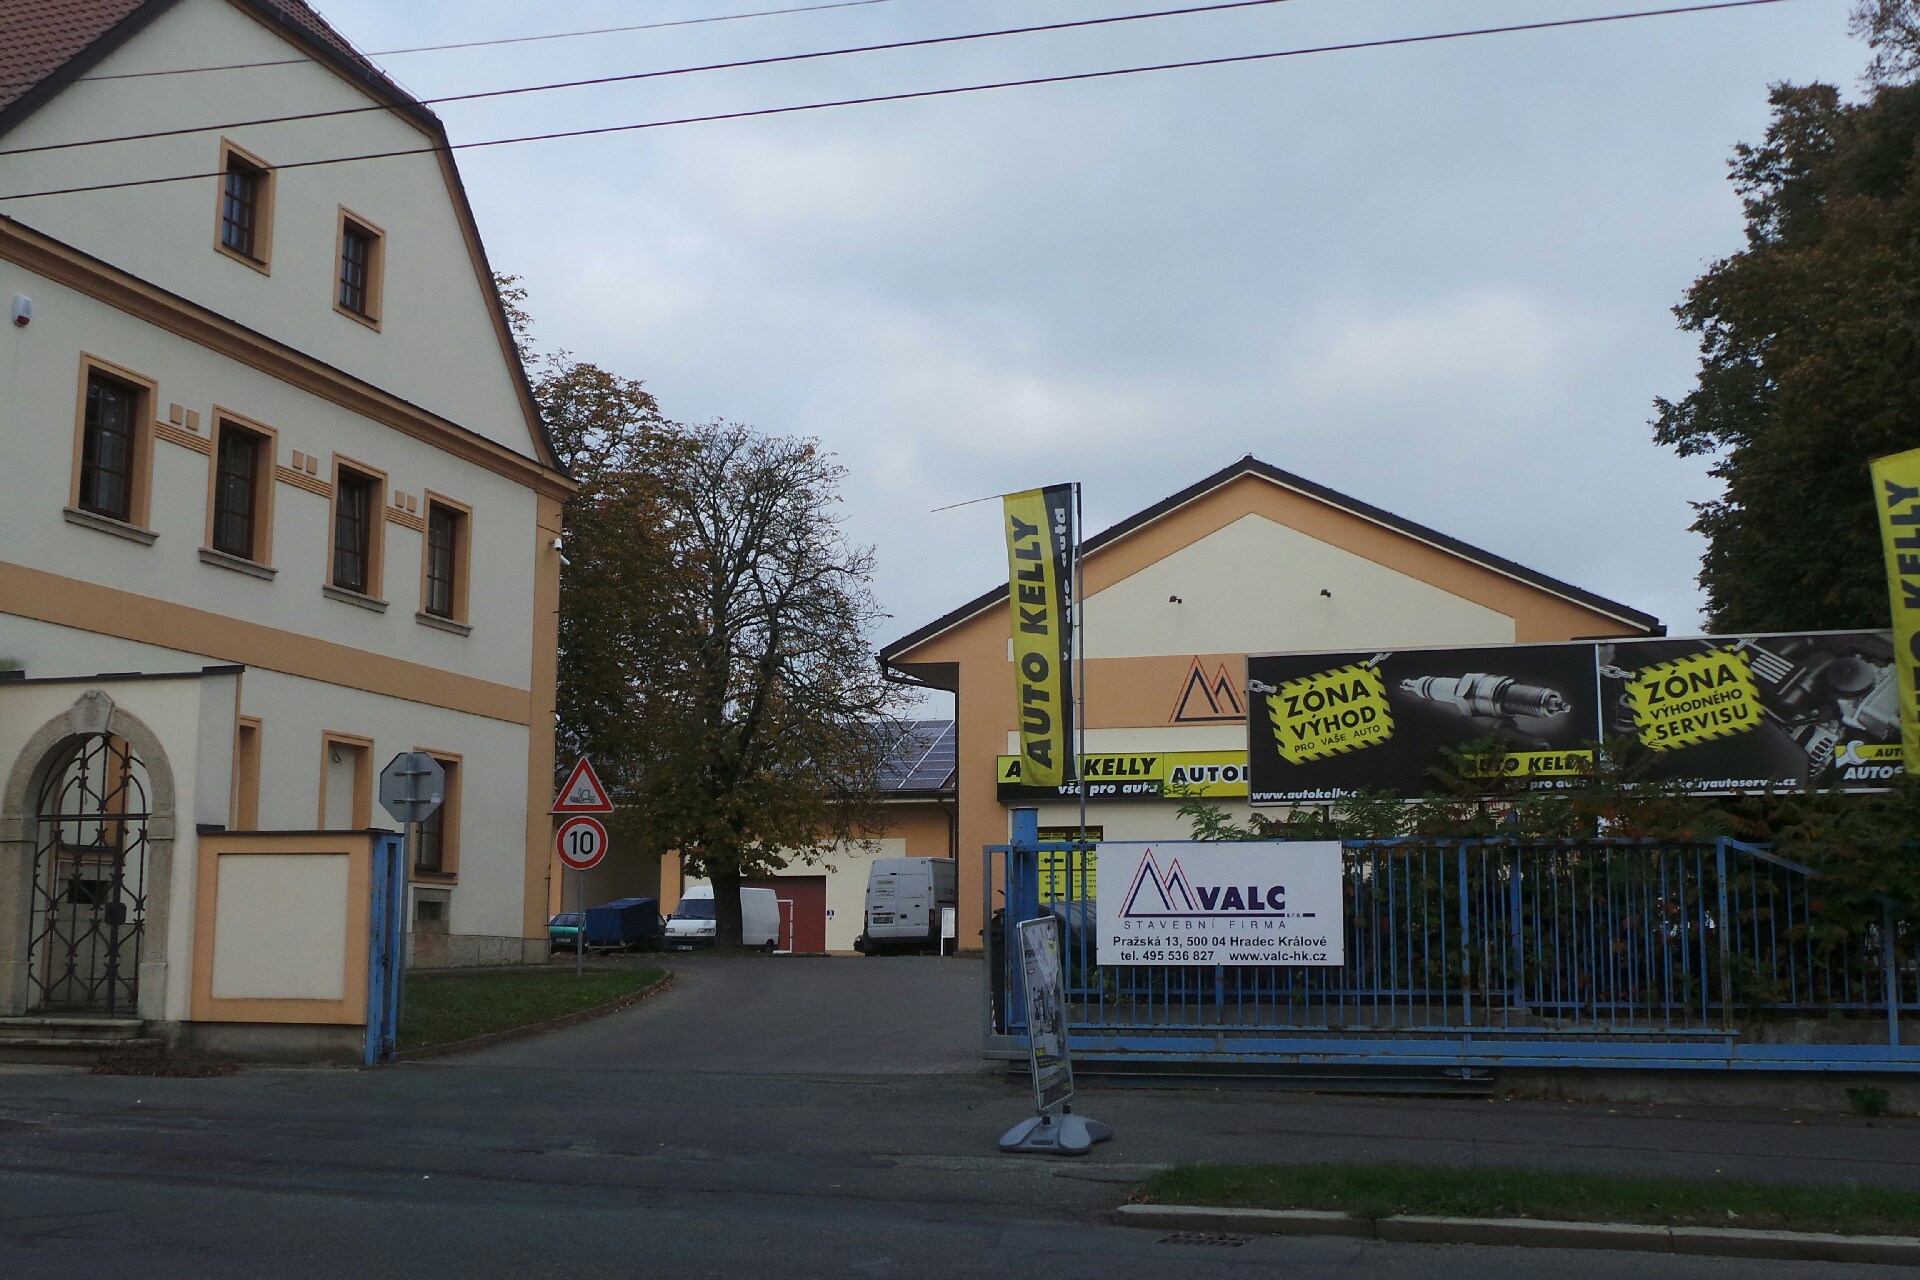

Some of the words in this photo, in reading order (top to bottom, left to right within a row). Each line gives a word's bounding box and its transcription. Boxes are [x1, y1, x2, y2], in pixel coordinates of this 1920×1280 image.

[1010, 515, 1048, 635] KELLY
[1644, 664, 1738, 705] ZÓNA
[1021, 652, 1053, 769] AUTO
[1284, 679, 1371, 718] ZÓNA
[1650, 688, 1742, 720] VÝHODNÉHO
[1290, 706, 1376, 741] VÝHOD
[1655, 703, 1749, 740] SERVISU
[1294, 742, 1315, 753] PRO
[1321, 733, 1346, 746] VAŠE
[1353, 725, 1381, 738] AUTO
[1084, 757, 1157, 776] KELLY
[1090, 785, 1116, 796] pro
[1530, 779, 1553, 791] pro
[570, 831, 594, 855] 10
[1196, 885, 1286, 911] VALC
[1124, 919, 1215, 930] STAVEBNÍ
[1229, 920, 1286, 930] FIRMA
[1113, 936, 1161, 947] Pražská
[1165, 936, 1182, 949] 13,
[1187, 936, 1208, 947] 500
[1211, 936, 1227, 947] 04
[1230, 936, 1275, 947] Hradec
[1278, 936, 1327, 947] Králové
[1121, 951, 1139, 961] tel.
[1143, 951, 1164, 961] 495
[1167, 951, 1189, 961] 536
[1192, 951, 1214, 961] 827
[1229, 951, 1327, 961] www.valc-hk.cz
